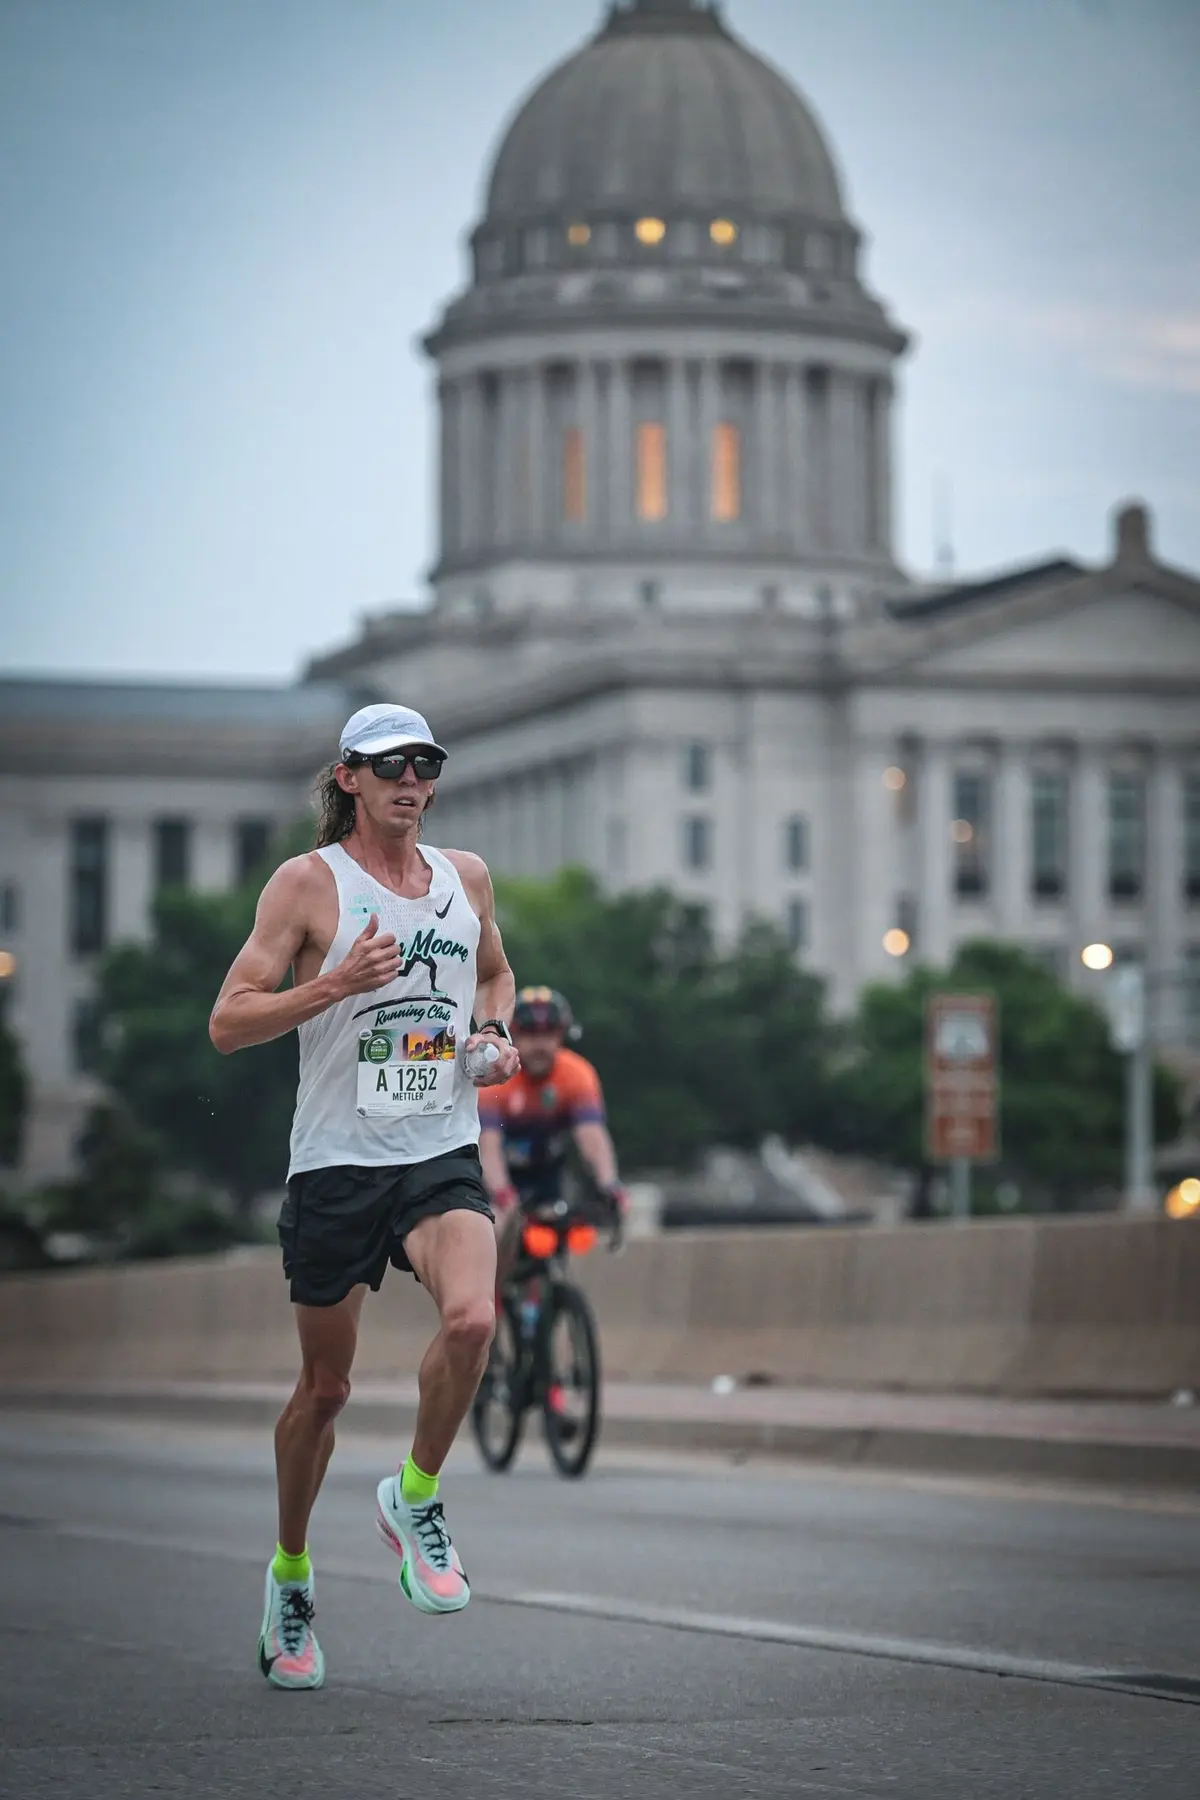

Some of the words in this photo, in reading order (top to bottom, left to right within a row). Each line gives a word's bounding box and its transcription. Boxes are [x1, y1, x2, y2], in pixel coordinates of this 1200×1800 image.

[407, 928, 469, 962] Moore
[374, 1004, 426, 1027] Running
[427, 1004, 451, 1022] Club
[376, 1069, 388, 1092] A
[396, 1067, 438, 1092] 1252
[392, 1092, 424, 1101] METTLER
